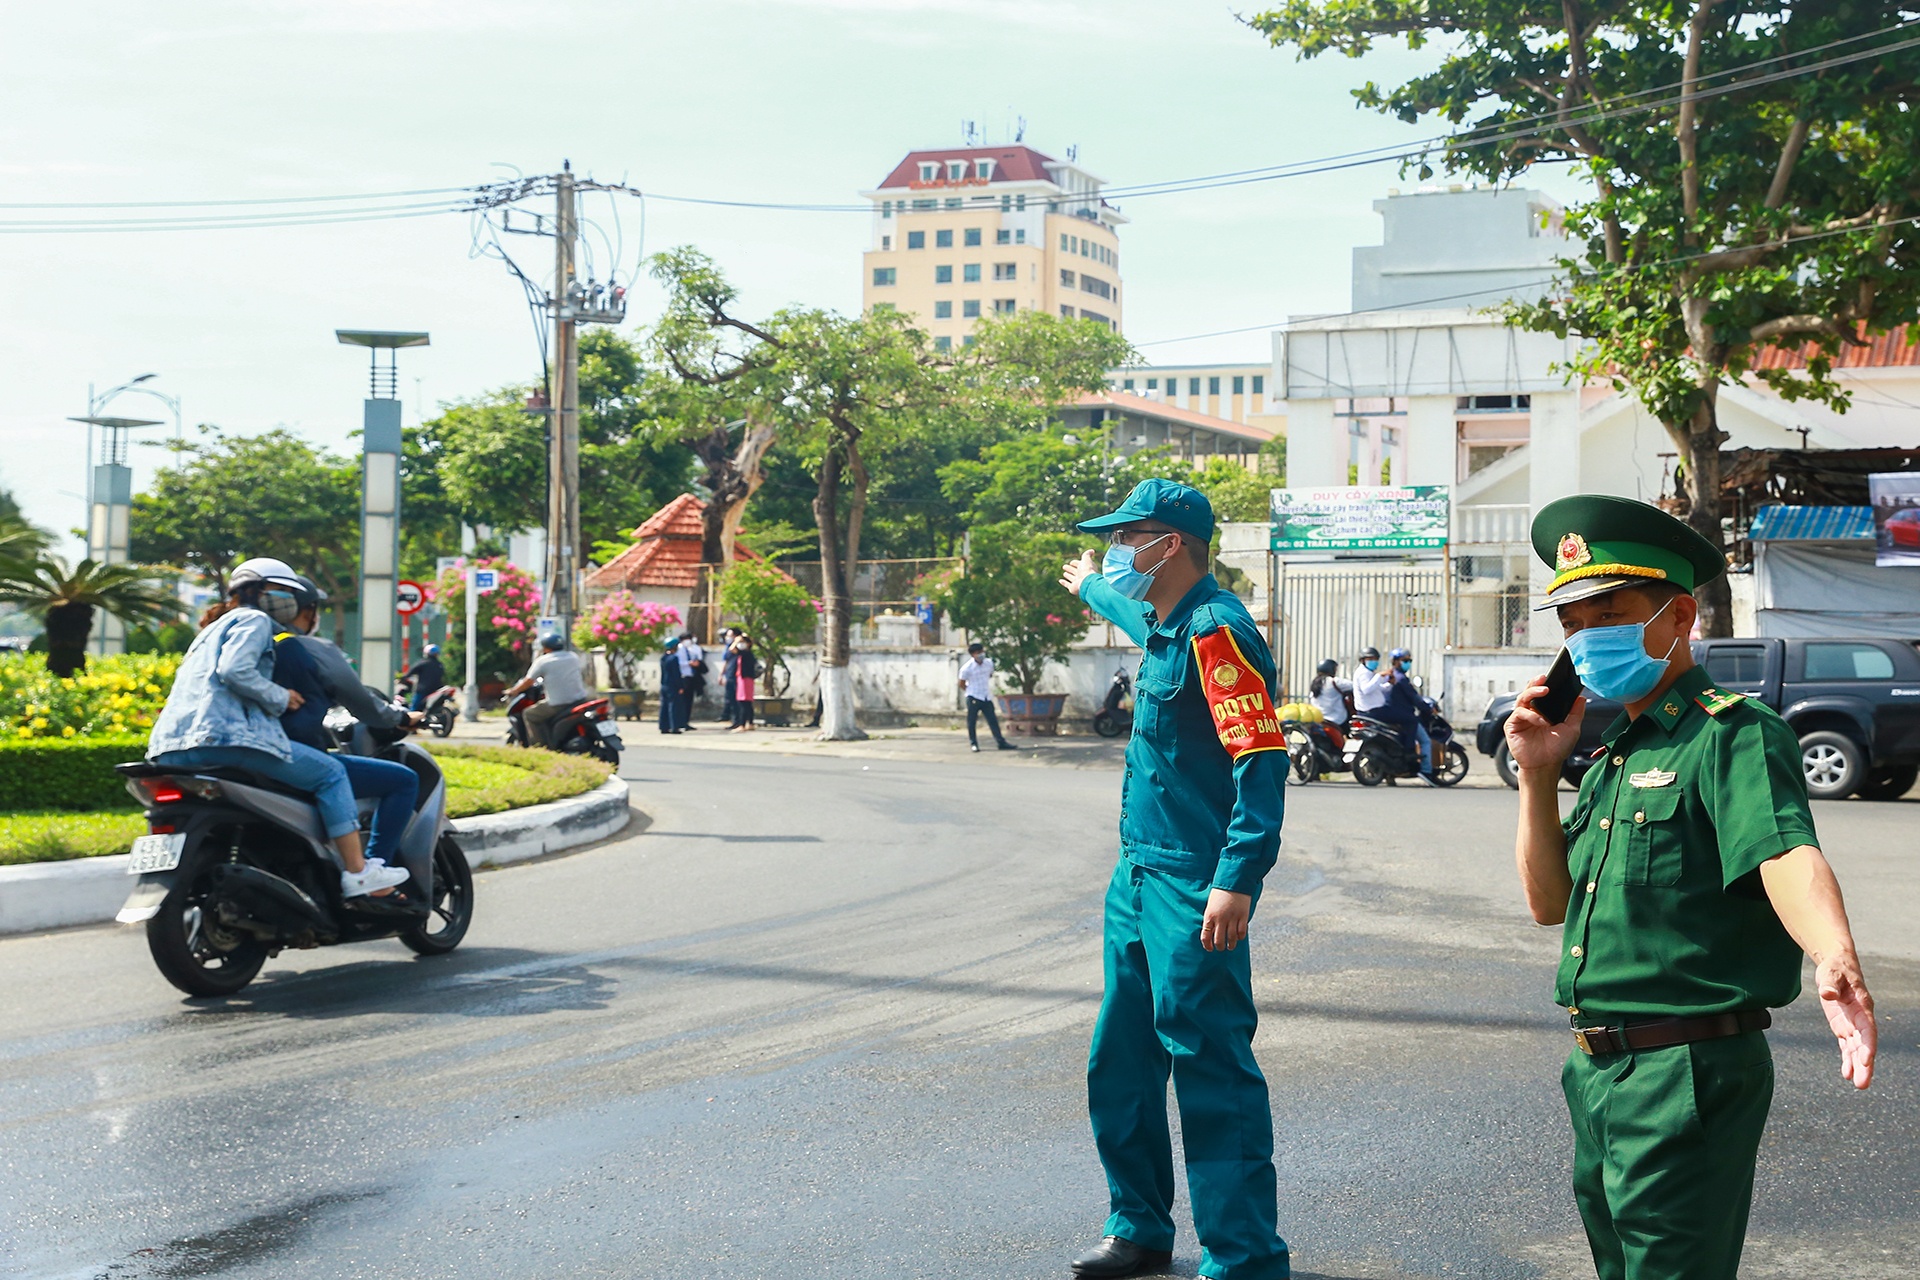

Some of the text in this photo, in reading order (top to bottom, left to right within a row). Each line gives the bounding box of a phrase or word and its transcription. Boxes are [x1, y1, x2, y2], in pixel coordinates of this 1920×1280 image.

[1313, 489, 1413, 501] DUY CÂY XANH
[1214, 693, 1264, 722] DQTV
[1229, 722, 1249, 741] TRA
[1256, 714, 1277, 733] BẢO
